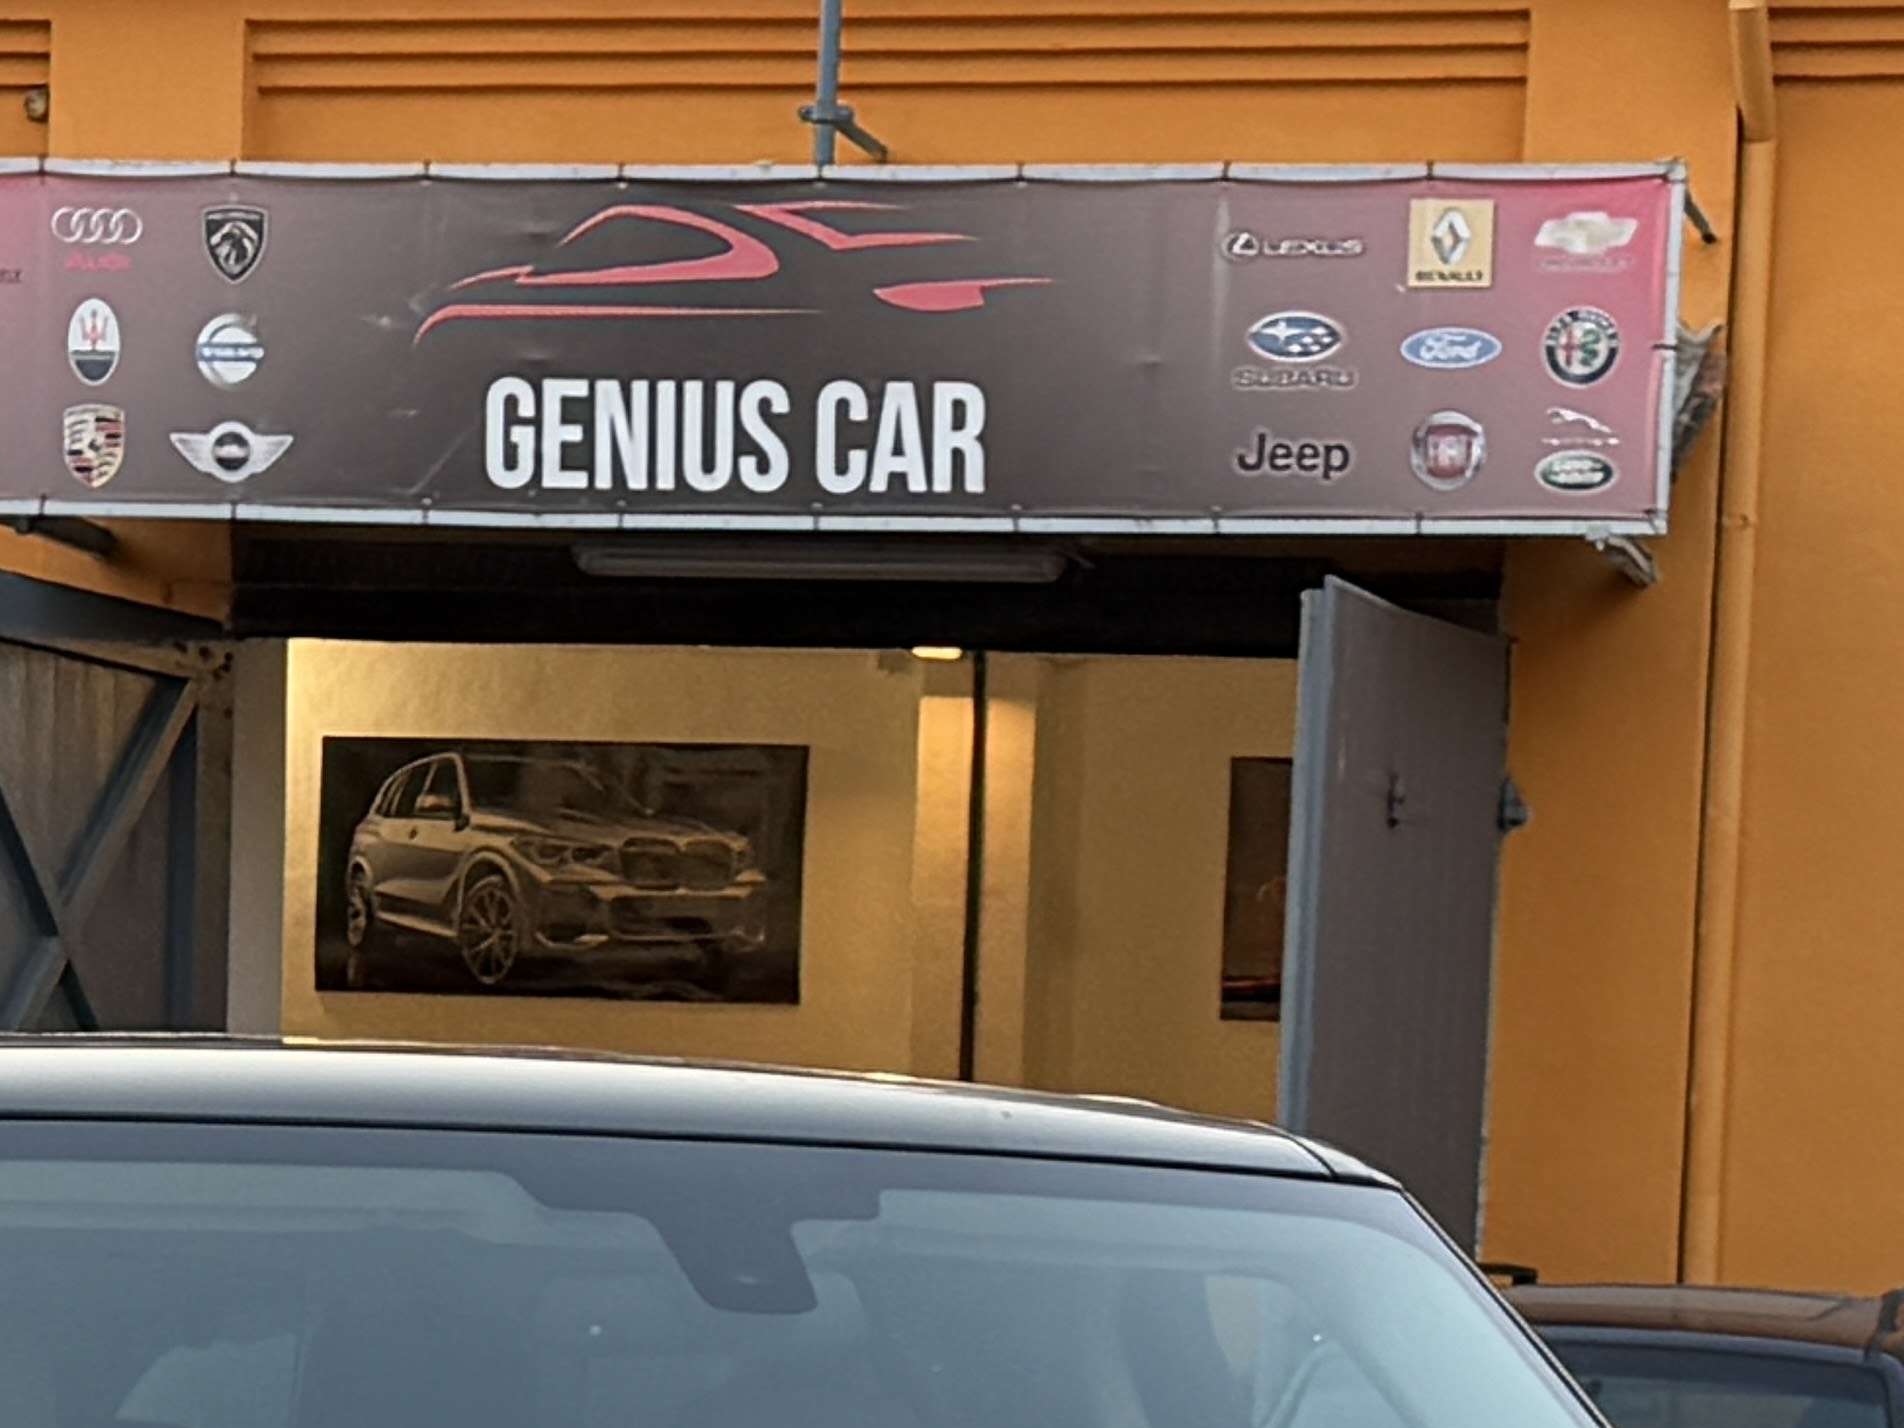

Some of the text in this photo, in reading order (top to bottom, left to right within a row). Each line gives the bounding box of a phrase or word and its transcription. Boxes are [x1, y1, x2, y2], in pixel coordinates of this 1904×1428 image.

[485, 376, 986, 494] GENIUS CAR
[1237, 432, 1350, 479] Jeep
